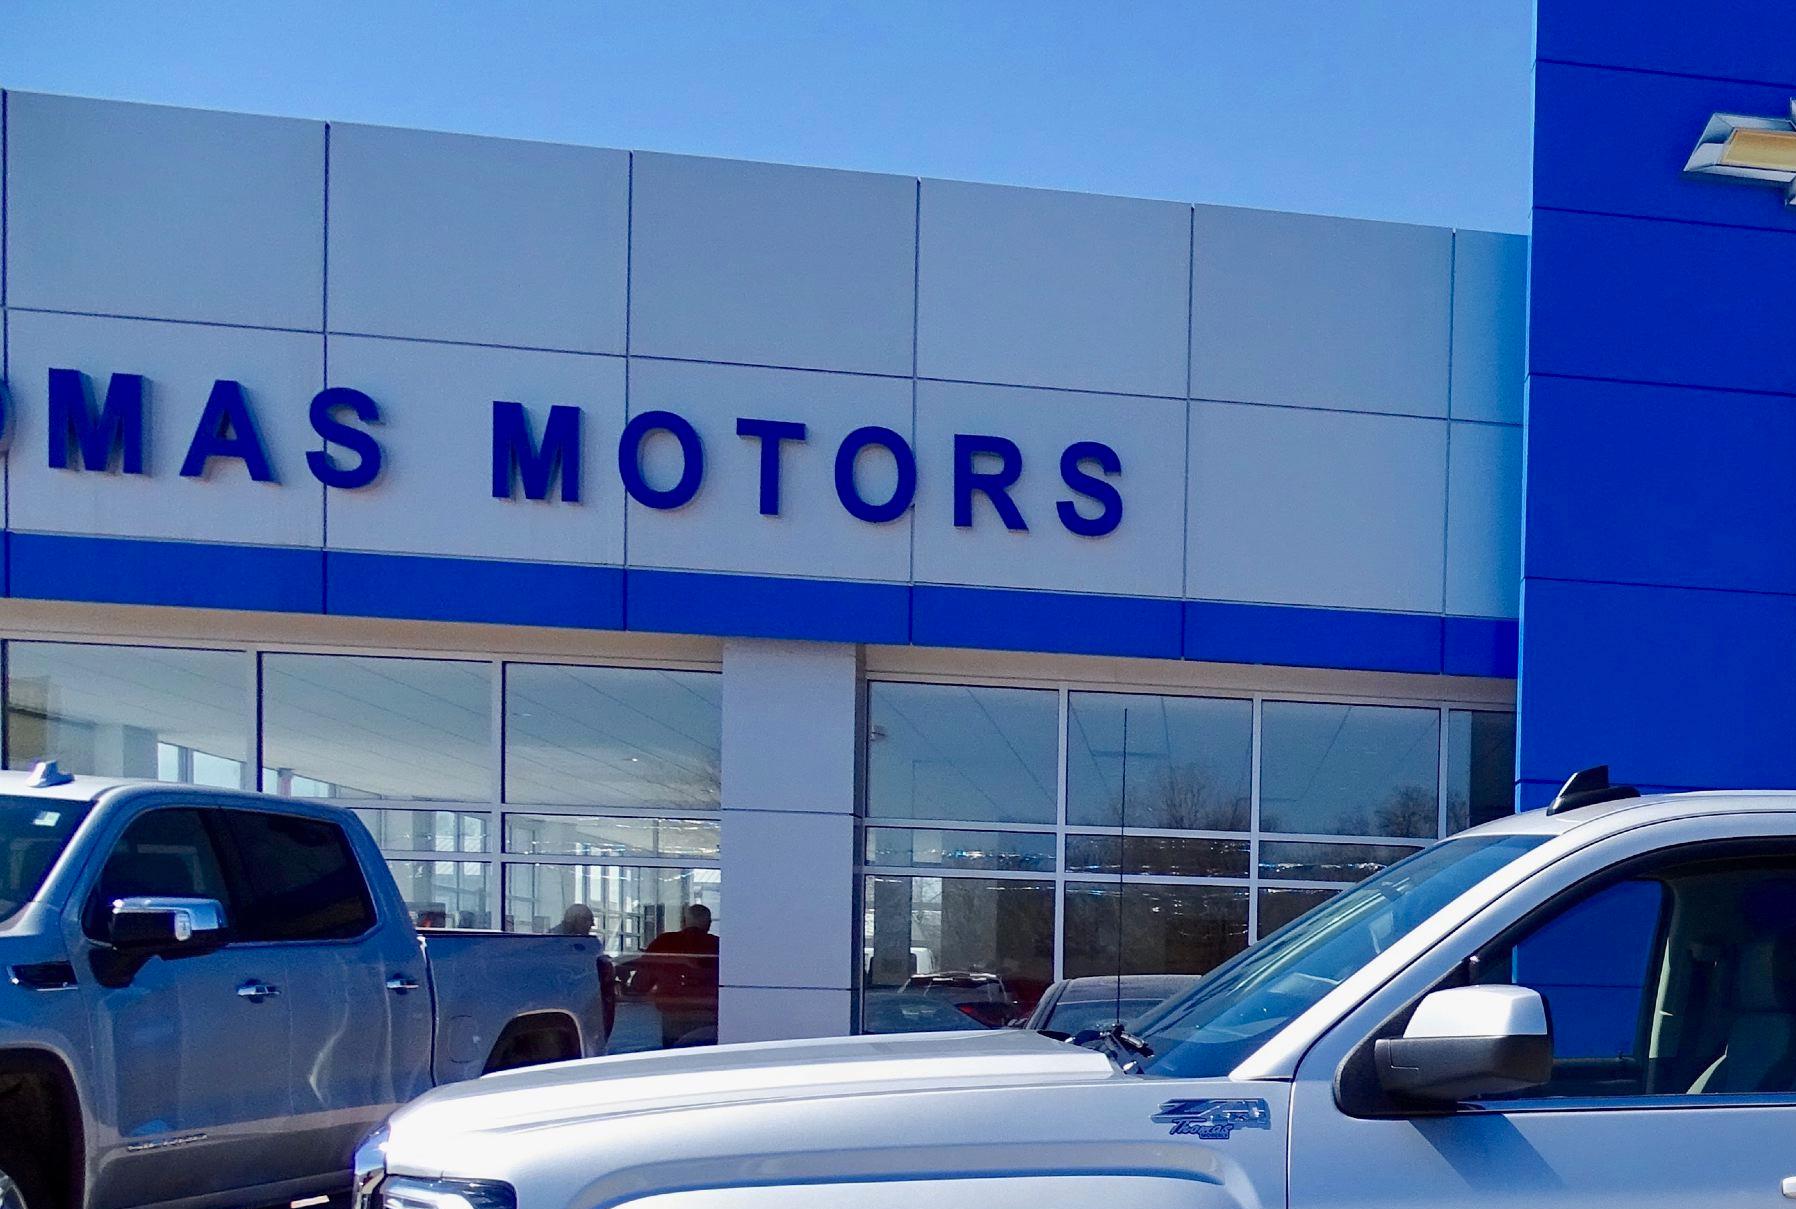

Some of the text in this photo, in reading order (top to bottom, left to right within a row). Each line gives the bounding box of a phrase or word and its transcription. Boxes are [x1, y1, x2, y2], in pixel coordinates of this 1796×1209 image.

[0, 366, 1124, 538] MAS MOTORS
[1169, 1117, 1234, 1135] Thomas
